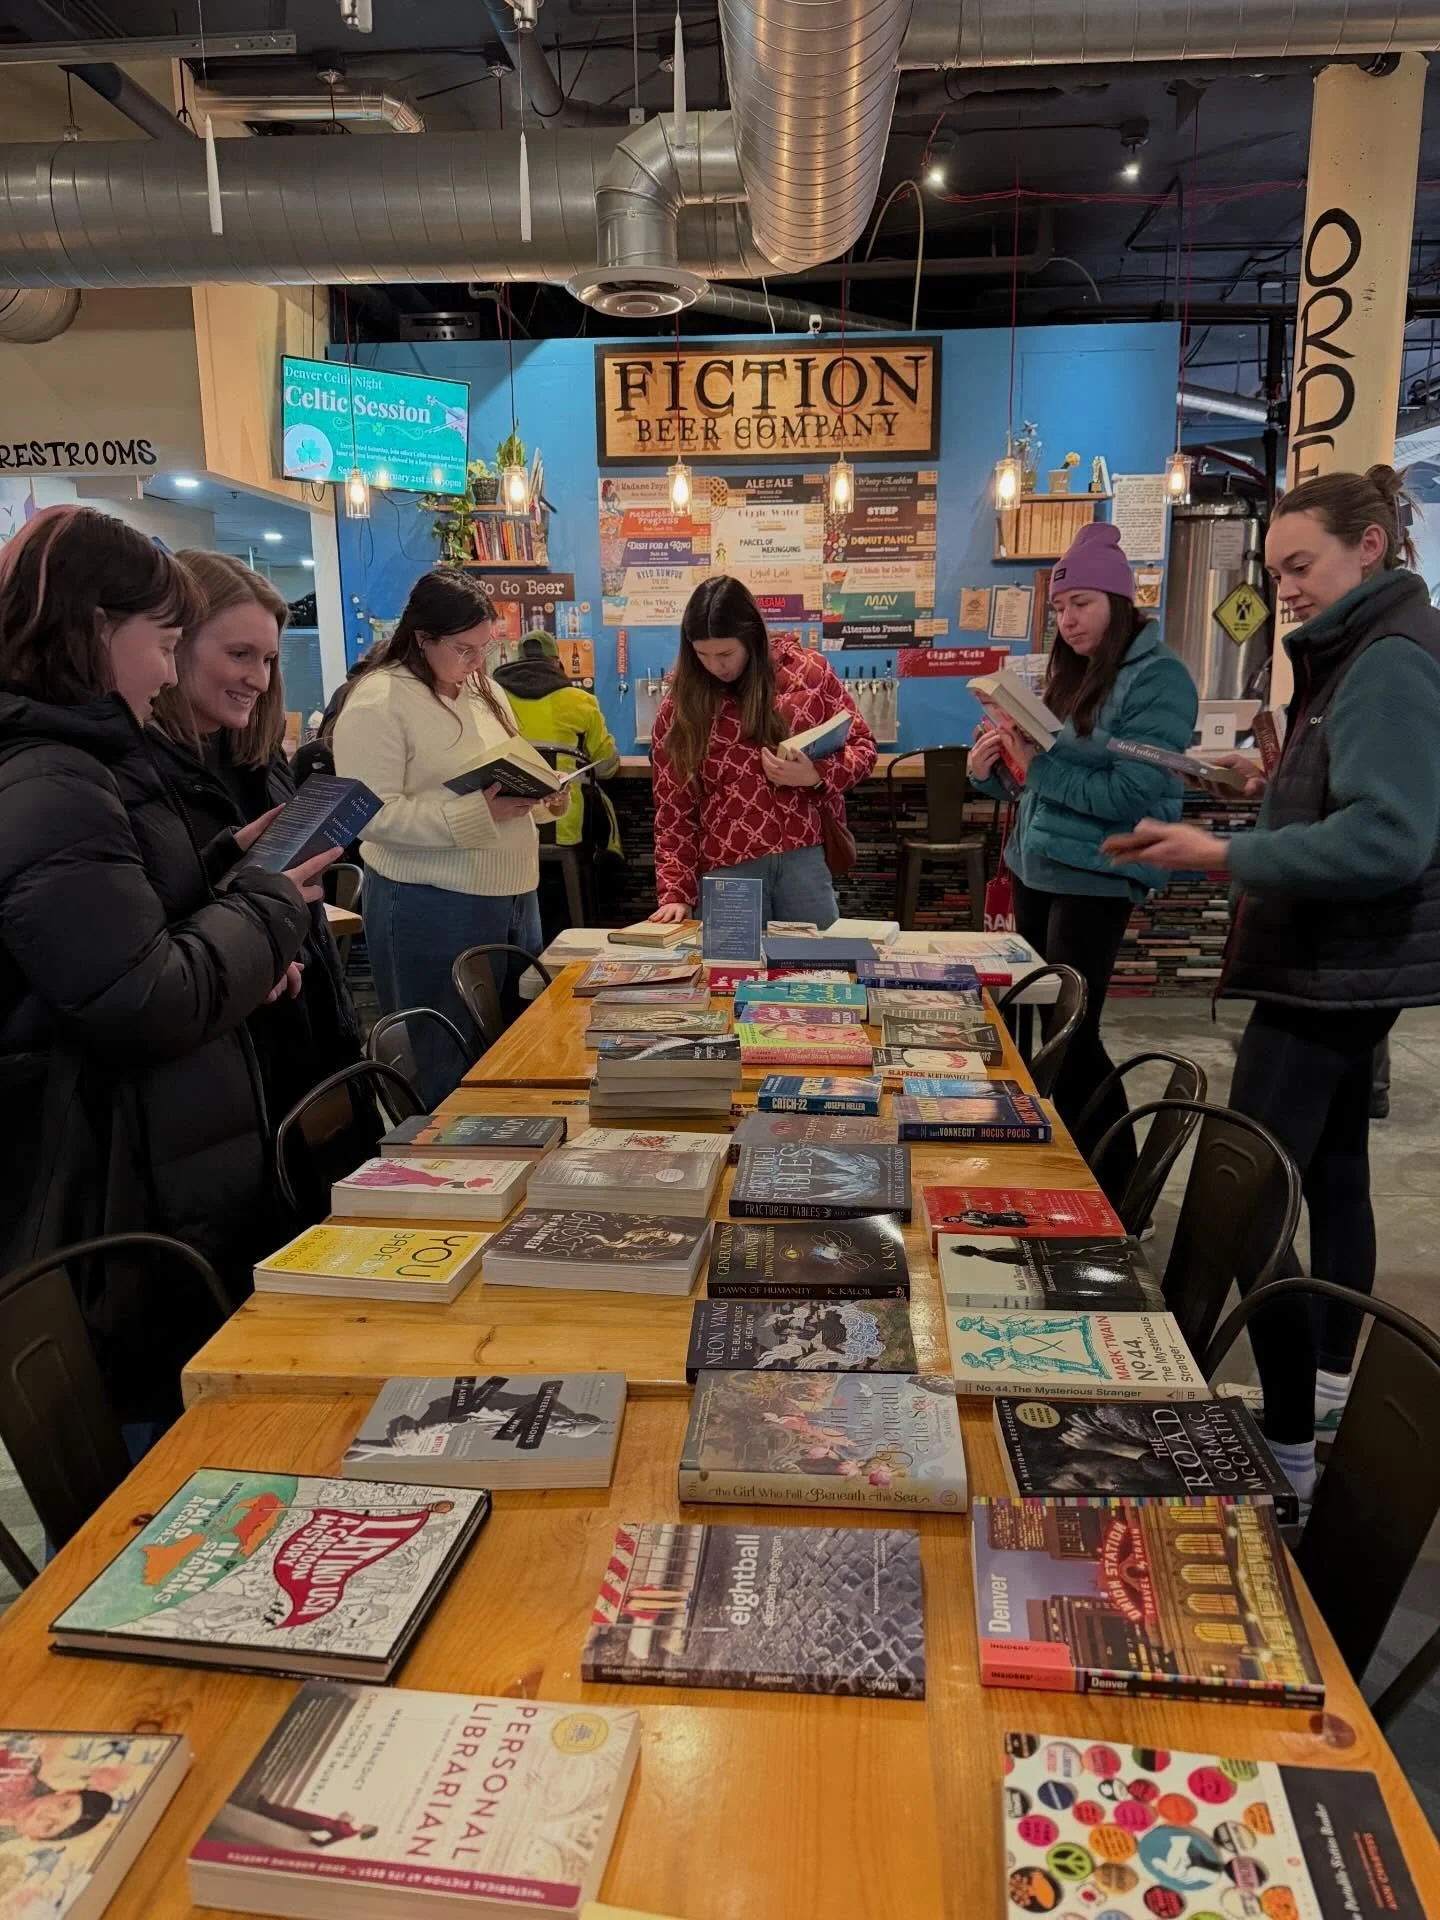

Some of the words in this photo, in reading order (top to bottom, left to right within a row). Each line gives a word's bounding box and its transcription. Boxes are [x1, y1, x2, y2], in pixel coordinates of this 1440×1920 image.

[1292, 207, 1362, 485] ORDE
[285, 366, 322, 382] Denver
[355, 376, 383, 391] Night
[612, 355, 928, 412] FICTION
[285, 385, 348, 413] Celtic
[353, 394, 432, 424] Session
[636, 417, 722, 442] BEER
[735, 412, 900, 440] COMPANY
[0, 439, 158, 468] RESTROOMS
[745, 480, 765, 488] ALE
[774, 478, 794, 487] ALE
[866, 506, 899, 515] STEEP
[884, 535, 915, 544] PANIC
[500, 579, 520, 595] Go
[526, 579, 565, 596] Beer
[891, 1009, 934, 1021] LITTLE
[935, 1011, 962, 1022] LIFE
[887, 1069, 926, 1078] SLAPSTICK
[771, 1096, 808, 1111] CATCH-22
[823, 1100, 846, 1111] JOSEPH
[845, 1101, 866, 1112] HELLER
[939, 1127, 976, 1138] VONNEGUT
[980, 1128, 1004, 1138] HOCUS
[1006, 1128, 1031, 1139] POCUS
[745, 1203, 789, 1216] FRACTURED
[791, 1205, 821, 1218] FABLES
[395, 1234, 470, 1278] YOU
[716, 1224, 734, 1276] GENERATIONS
[718, 1285, 750, 1295] DAWN
[750, 1286, 763, 1295] OF
[763, 1286, 811, 1296] HUMANITY
[839, 1287, 872, 1297] KALOR
[709, 1301, 729, 1328] YANG
[745, 1313, 755, 1339] HEAVEN
[732, 1323, 743, 1345] BLACK
[744, 1341, 753, 1351] OF
[1095, 1315, 1119, 1349] TWAIN
[1140, 1316, 1169, 1364] Mysterious
[704, 1332, 727, 1365] NEON
[730, 1346, 740, 1361] THE
[1169, 1344, 1195, 1383] Stranger
[1109, 1350, 1133, 1381] MARK
[1161, 1365, 1177, 1383] The
[975, 1384, 994, 1393] No.
[1012, 1385, 1032, 1394] The
[1034, 1385, 1093, 1397] Mysterious
[1095, 1387, 1142, 1398] Stranger
[1148, 1436, 1170, 1459] THE
[1152, 1408, 1215, 1488] ROAD
[1188, 1412, 1239, 1482] CORMAC
[732, 1485, 756, 1498] Girl
[758, 1487, 784, 1499] Who
[785, 1488, 804, 1499] Fell
[809, 1487, 866, 1503] Beneath
[893, 1490, 918, 1504] Sea
[154, 1495, 206, 1545] ALCARAZ
[175, 1498, 221, 1540] LALO
[337, 1516, 362, 1526] A
[278, 1513, 339, 1567] HISTORY
[291, 1527, 348, 1580] CARTOON
[310, 1517, 423, 1585] LATINO
[1104, 1521, 1127, 1577] STATION
[1131, 1527, 1146, 1559] TRAIN
[153, 1541, 218, 1604] STAVANS
[181, 1541, 240, 1592] ILAN
[725, 1533, 761, 1626] eightball
[297, 1586, 340, 1616] USA
[988, 1574, 1012, 1633] Denver
[1107, 1580, 1142, 1622] UNION
[1091, 1676, 1128, 1691] Denver
[406, 1702, 499, 1857] LIBRARIAN
[451, 1705, 539, 1861] PERSONAL
